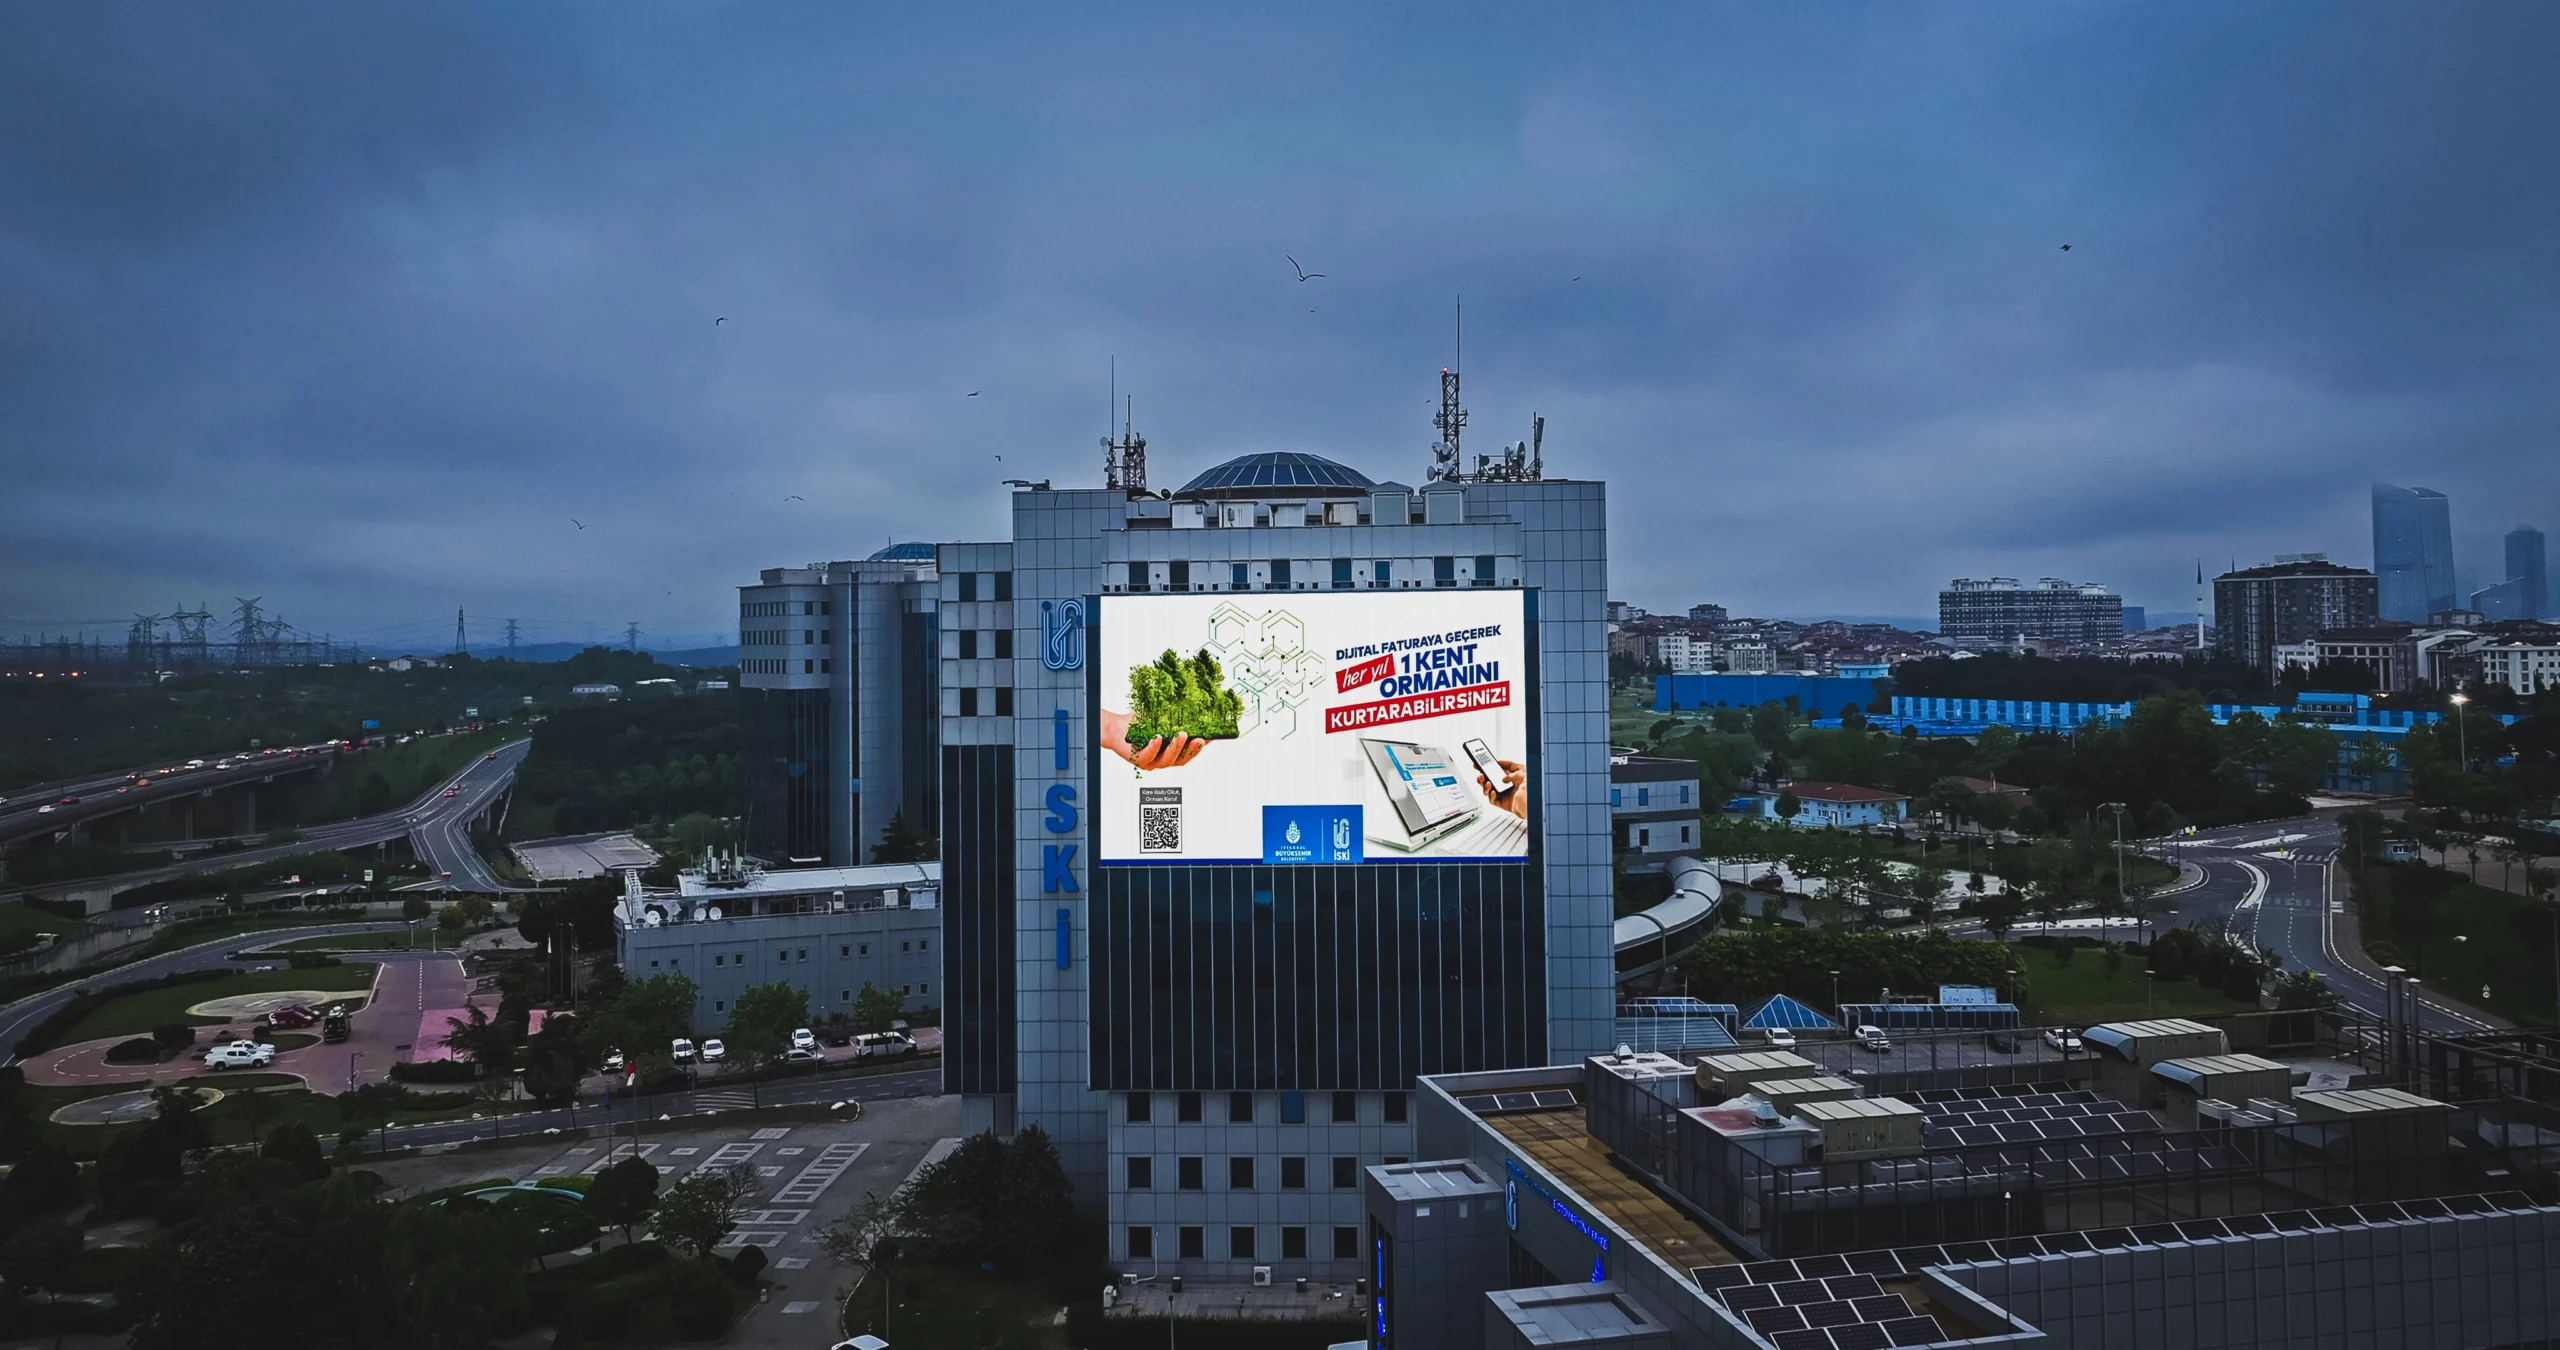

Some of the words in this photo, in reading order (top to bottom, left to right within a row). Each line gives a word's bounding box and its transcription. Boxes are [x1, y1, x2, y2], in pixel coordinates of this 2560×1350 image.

[1381, 634, 1443, 653] FATURAYA
[1445, 624, 1502, 643] GEÇEREK
[1342, 667, 1367, 689] her
[1371, 657, 1390, 683] yıl
[1401, 654, 1410, 674] 1
[1415, 643, 1478, 673] KENT
[1379, 661, 1499, 698] ORMANINI
